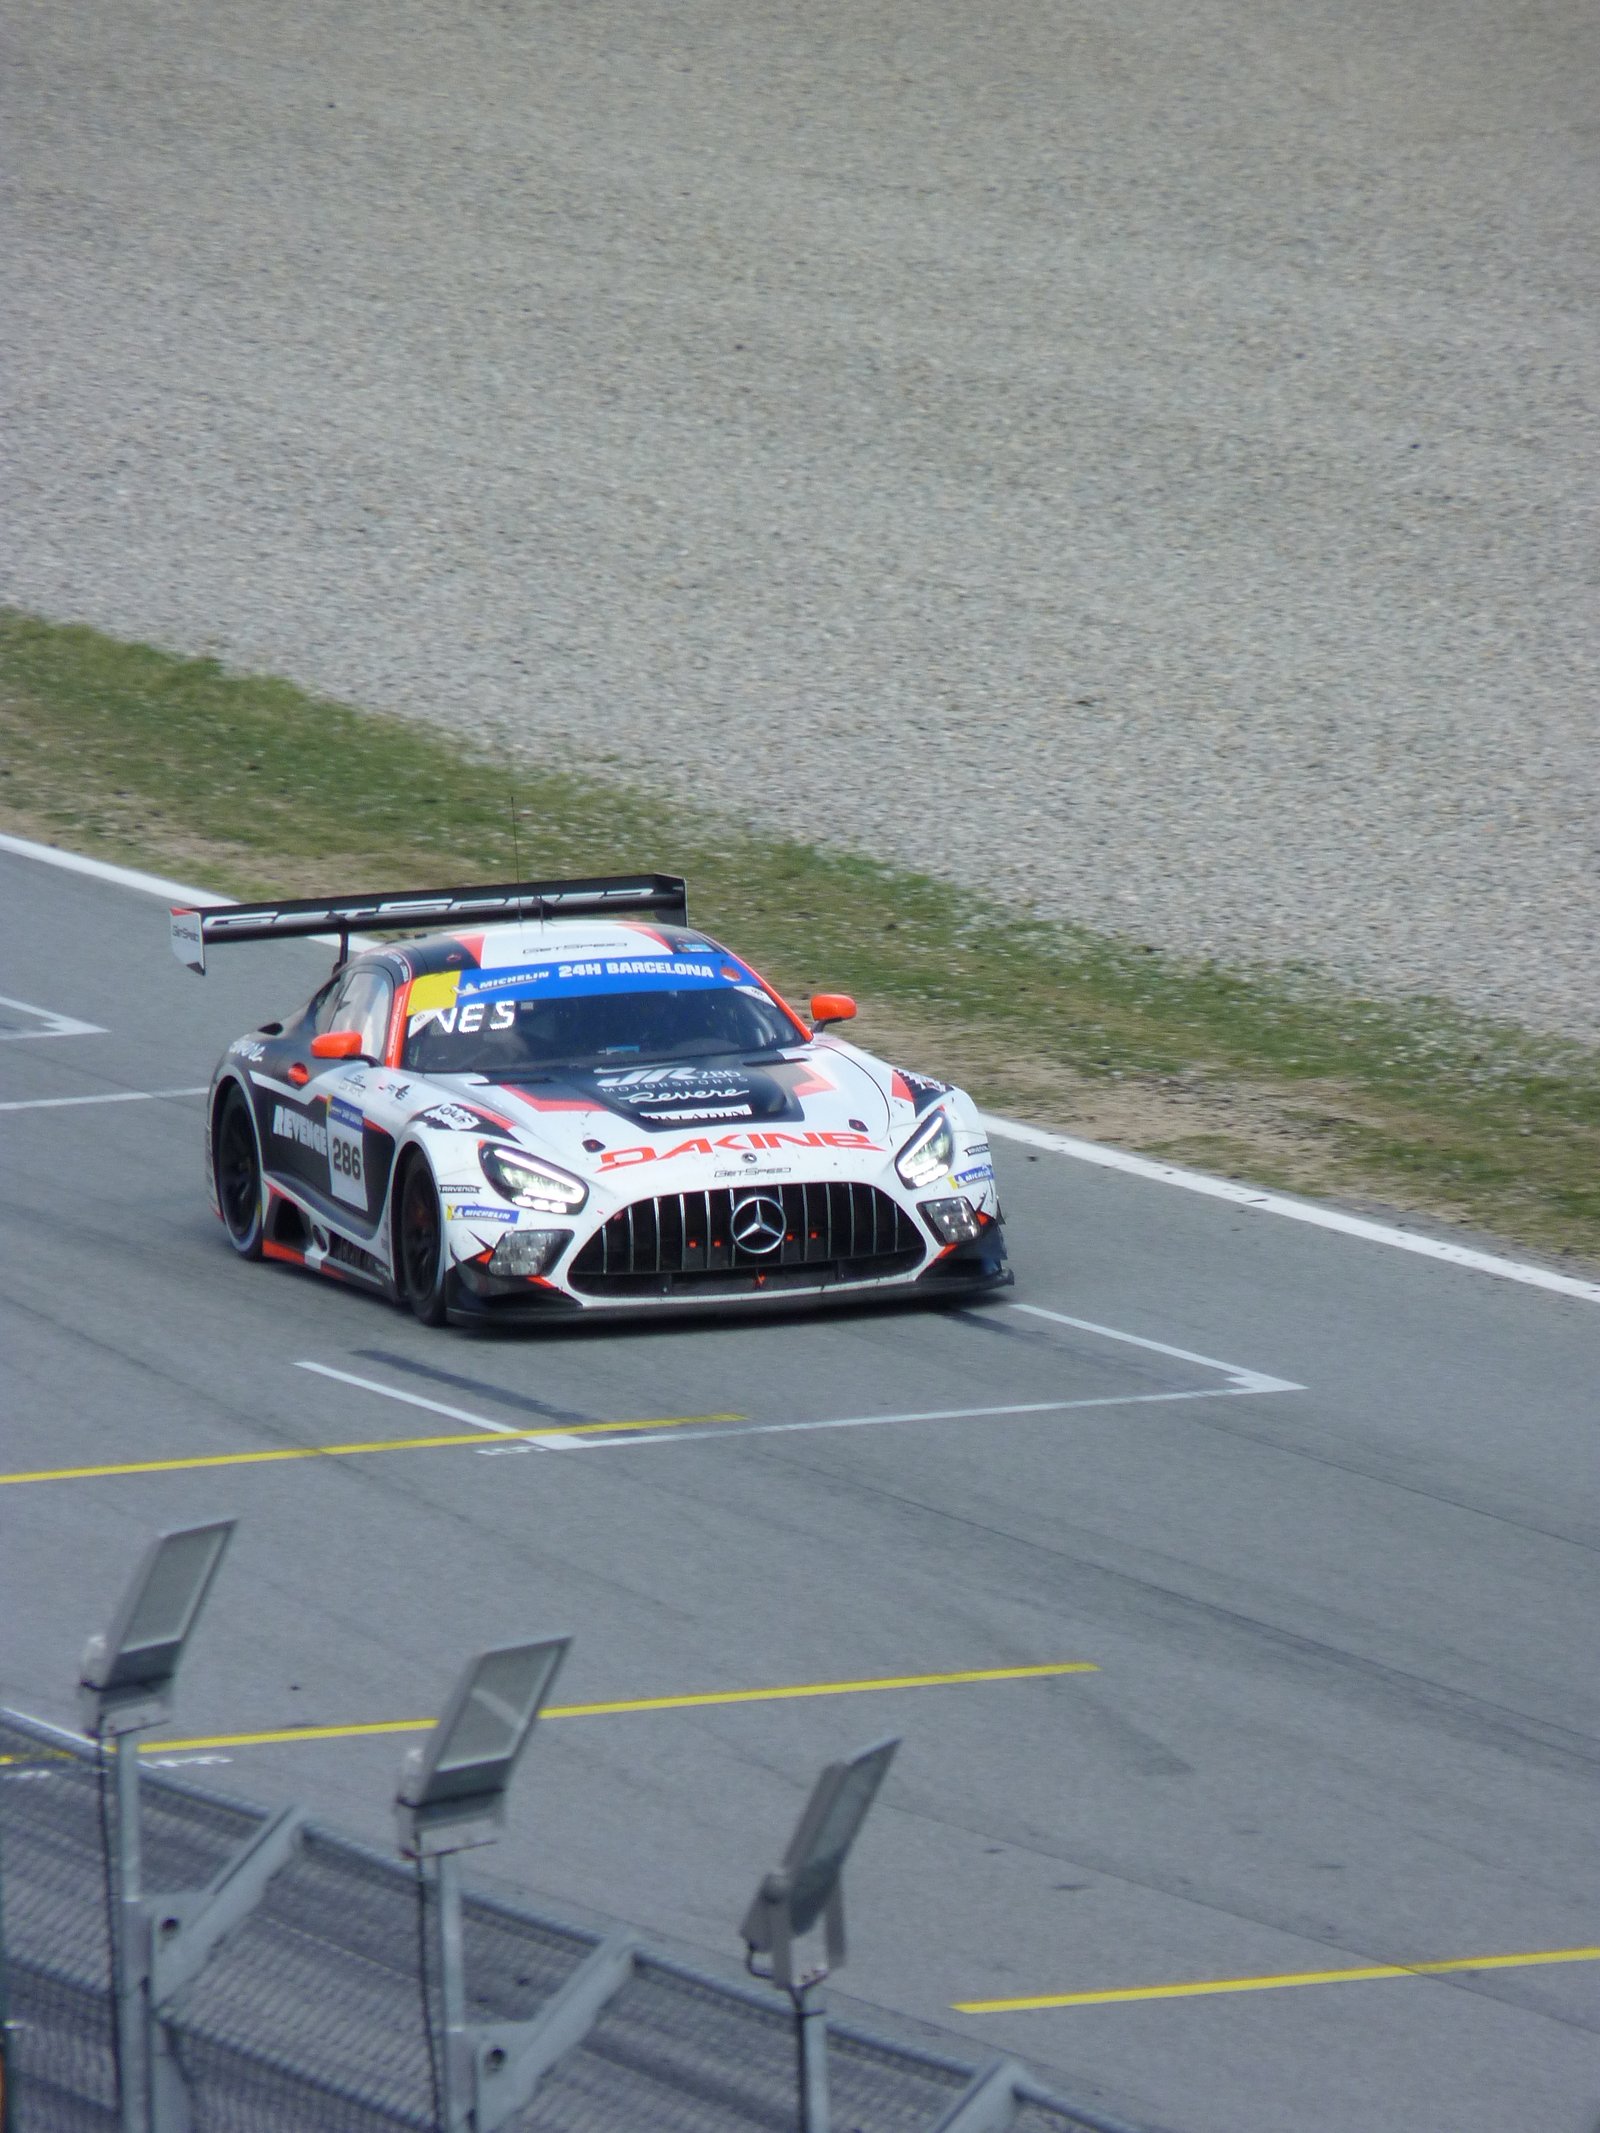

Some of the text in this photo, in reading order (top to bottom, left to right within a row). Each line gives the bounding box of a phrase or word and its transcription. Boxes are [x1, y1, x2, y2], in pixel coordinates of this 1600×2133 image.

[559, 961, 714, 978] 24H BARCELONA
[480, 971, 549, 988] MICHELIN
[602, 1077, 749, 1092] MOTORSPORTS
[618, 1088, 750, 1104] Revere
[332, 1136, 361, 1180] 286
[594, 1131, 887, 1174] DAKINE
[441, 1186, 478, 1195] RAVENOL
[464, 1210, 512, 1220] MICHELIN
